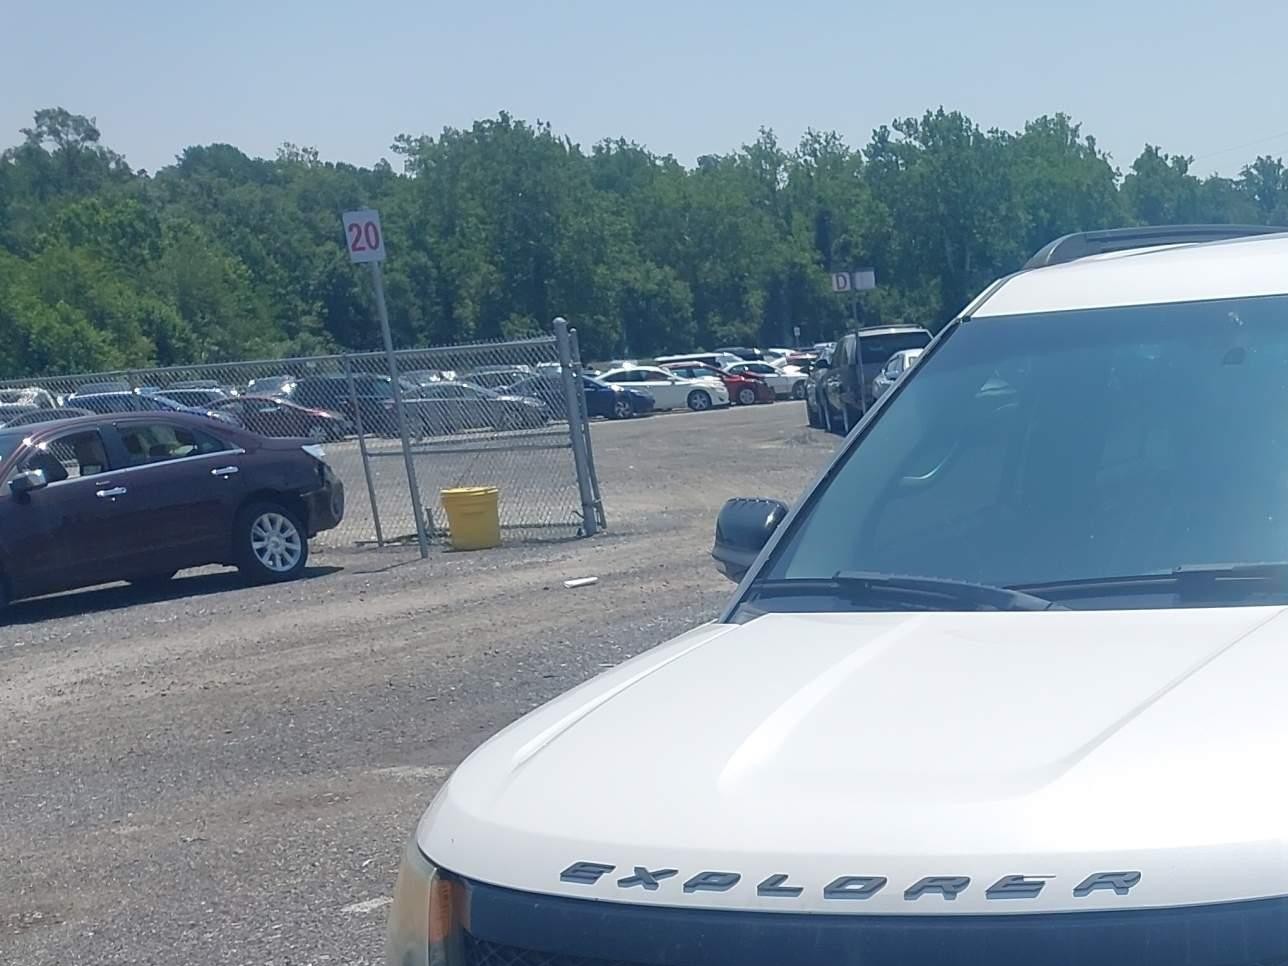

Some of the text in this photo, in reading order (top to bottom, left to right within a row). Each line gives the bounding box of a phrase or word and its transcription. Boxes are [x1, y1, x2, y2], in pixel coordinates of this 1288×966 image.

[348, 221, 380, 252] 20
[836, 274, 848, 290] D
[560, 861, 1142, 900] EXPLORER
